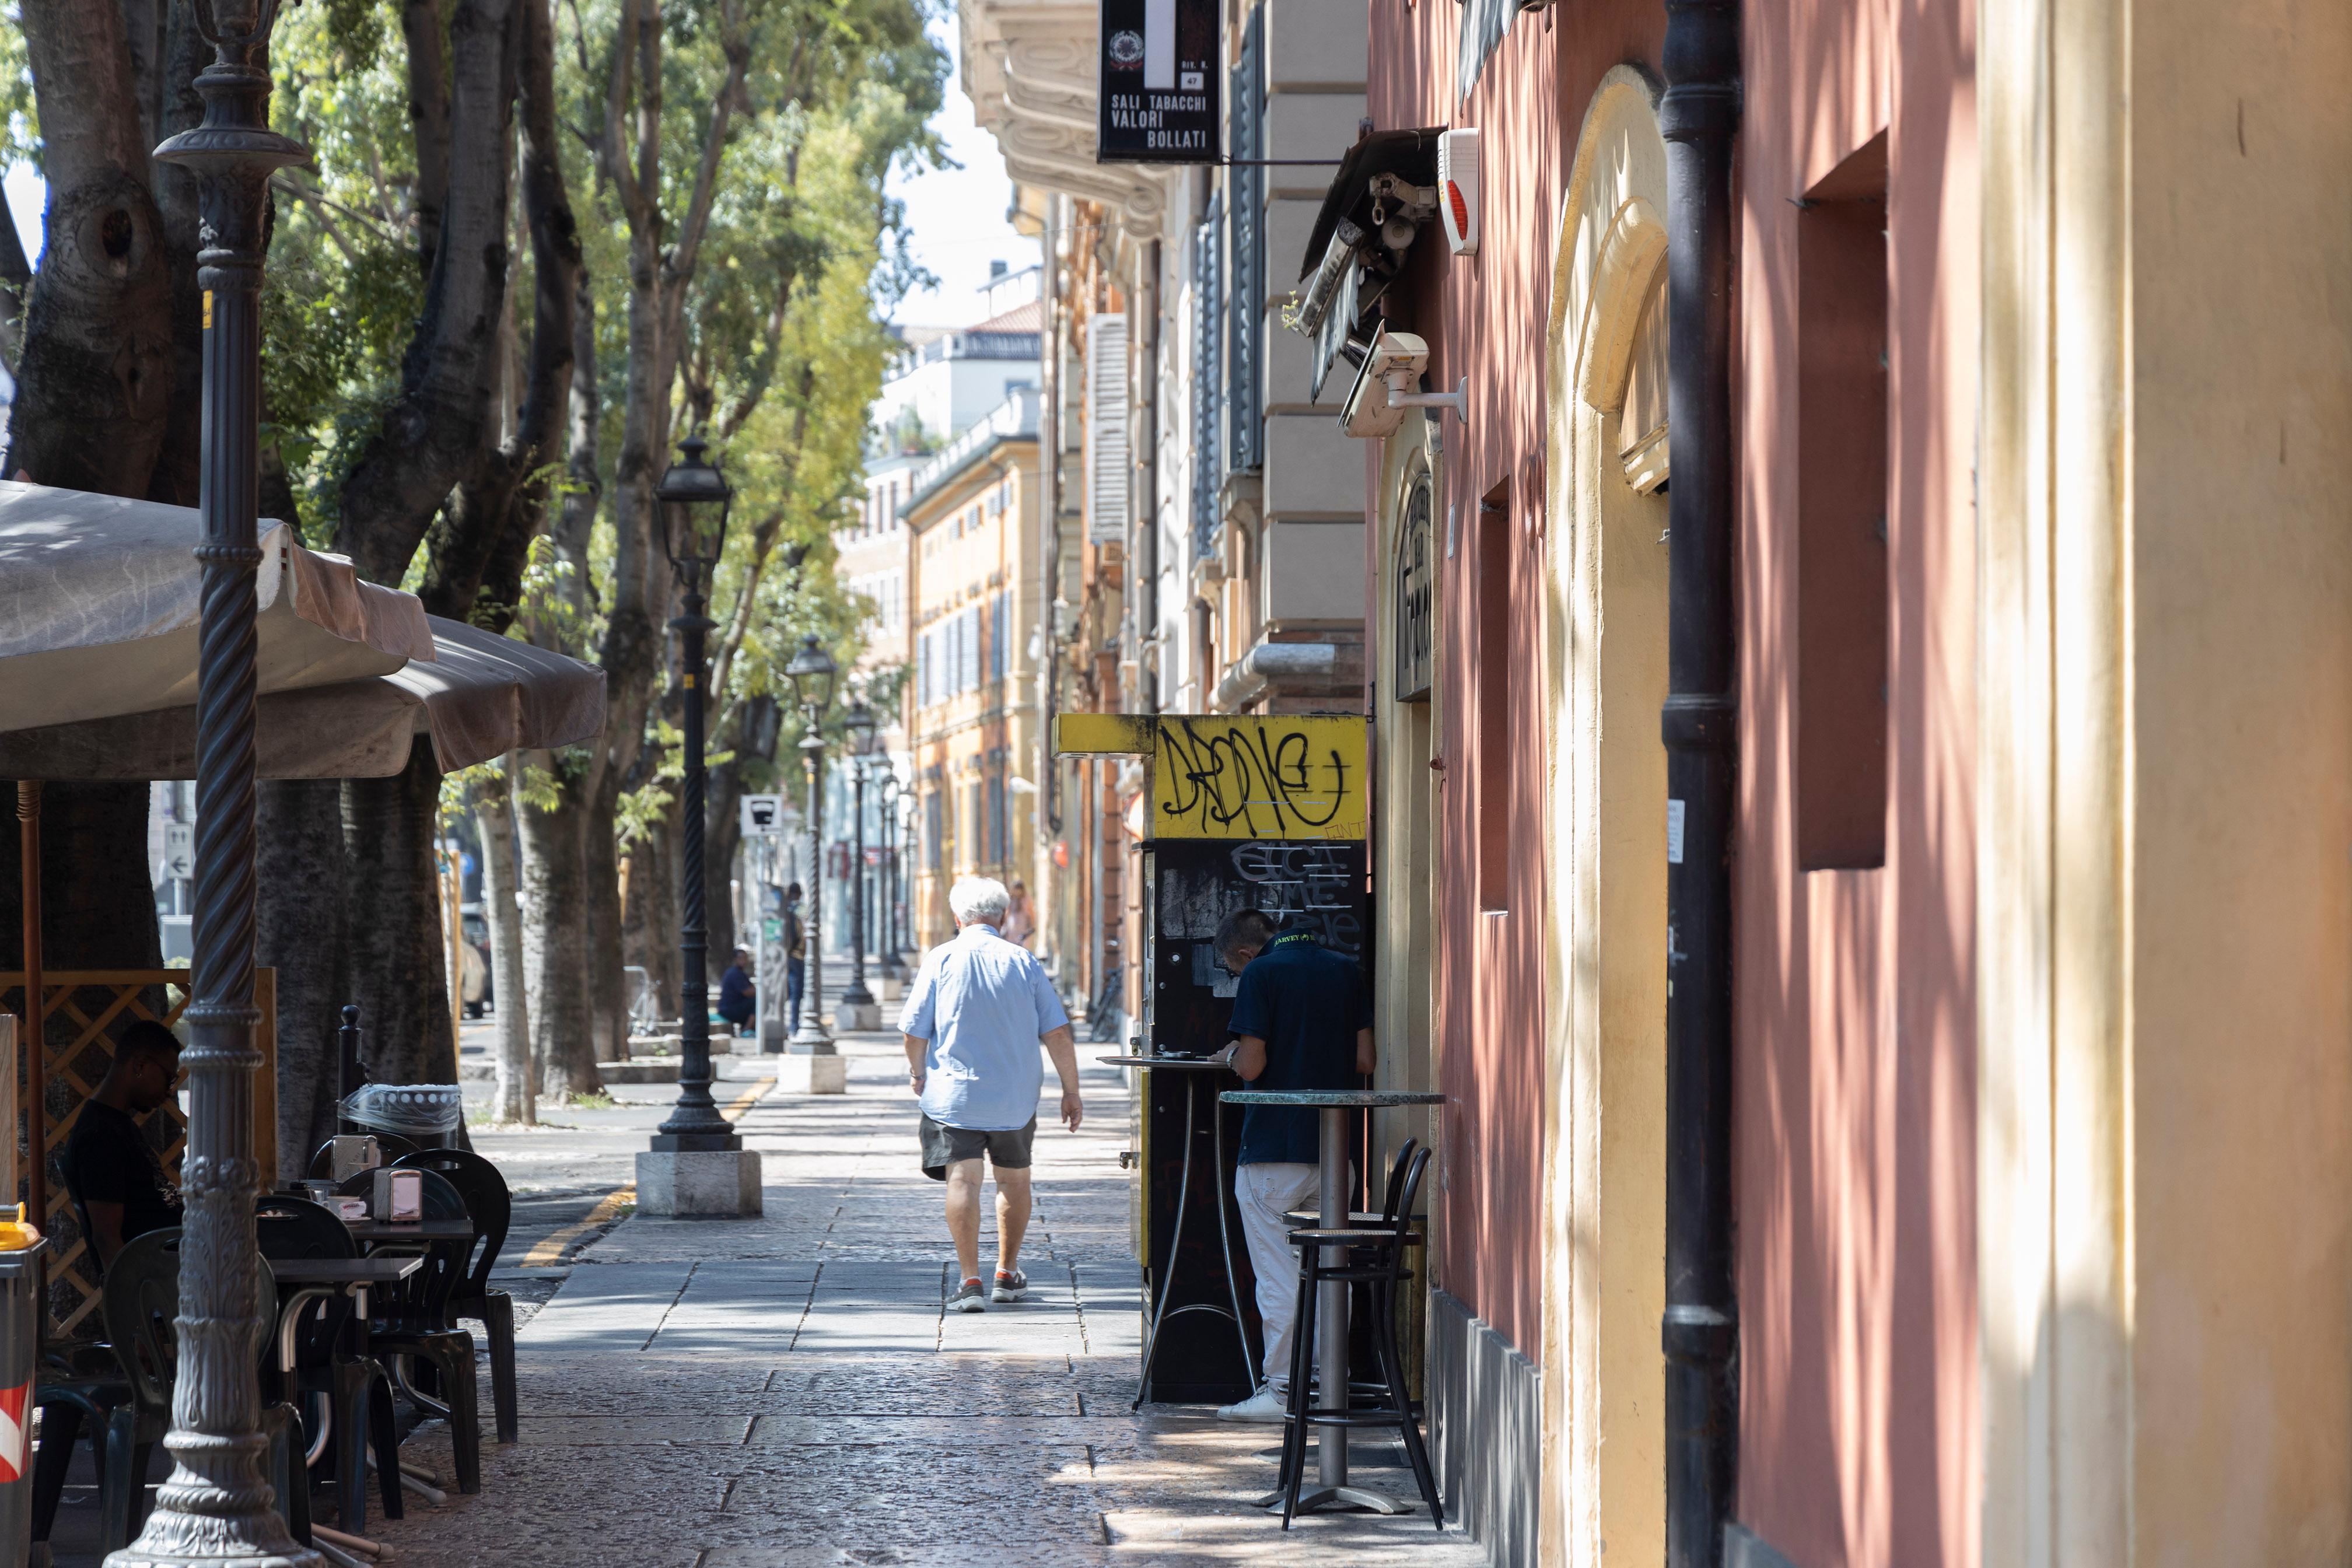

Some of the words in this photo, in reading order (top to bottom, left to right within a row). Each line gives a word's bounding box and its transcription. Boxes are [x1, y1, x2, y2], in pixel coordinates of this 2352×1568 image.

[1111, 94, 1140, 110] SALI
[1150, 95, 1206, 111] TABACCHI
[1111, 110, 1163, 128] VALORI
[1147, 130, 1206, 148] BOLLATI
[1415, 531, 1423, 572] BAR
